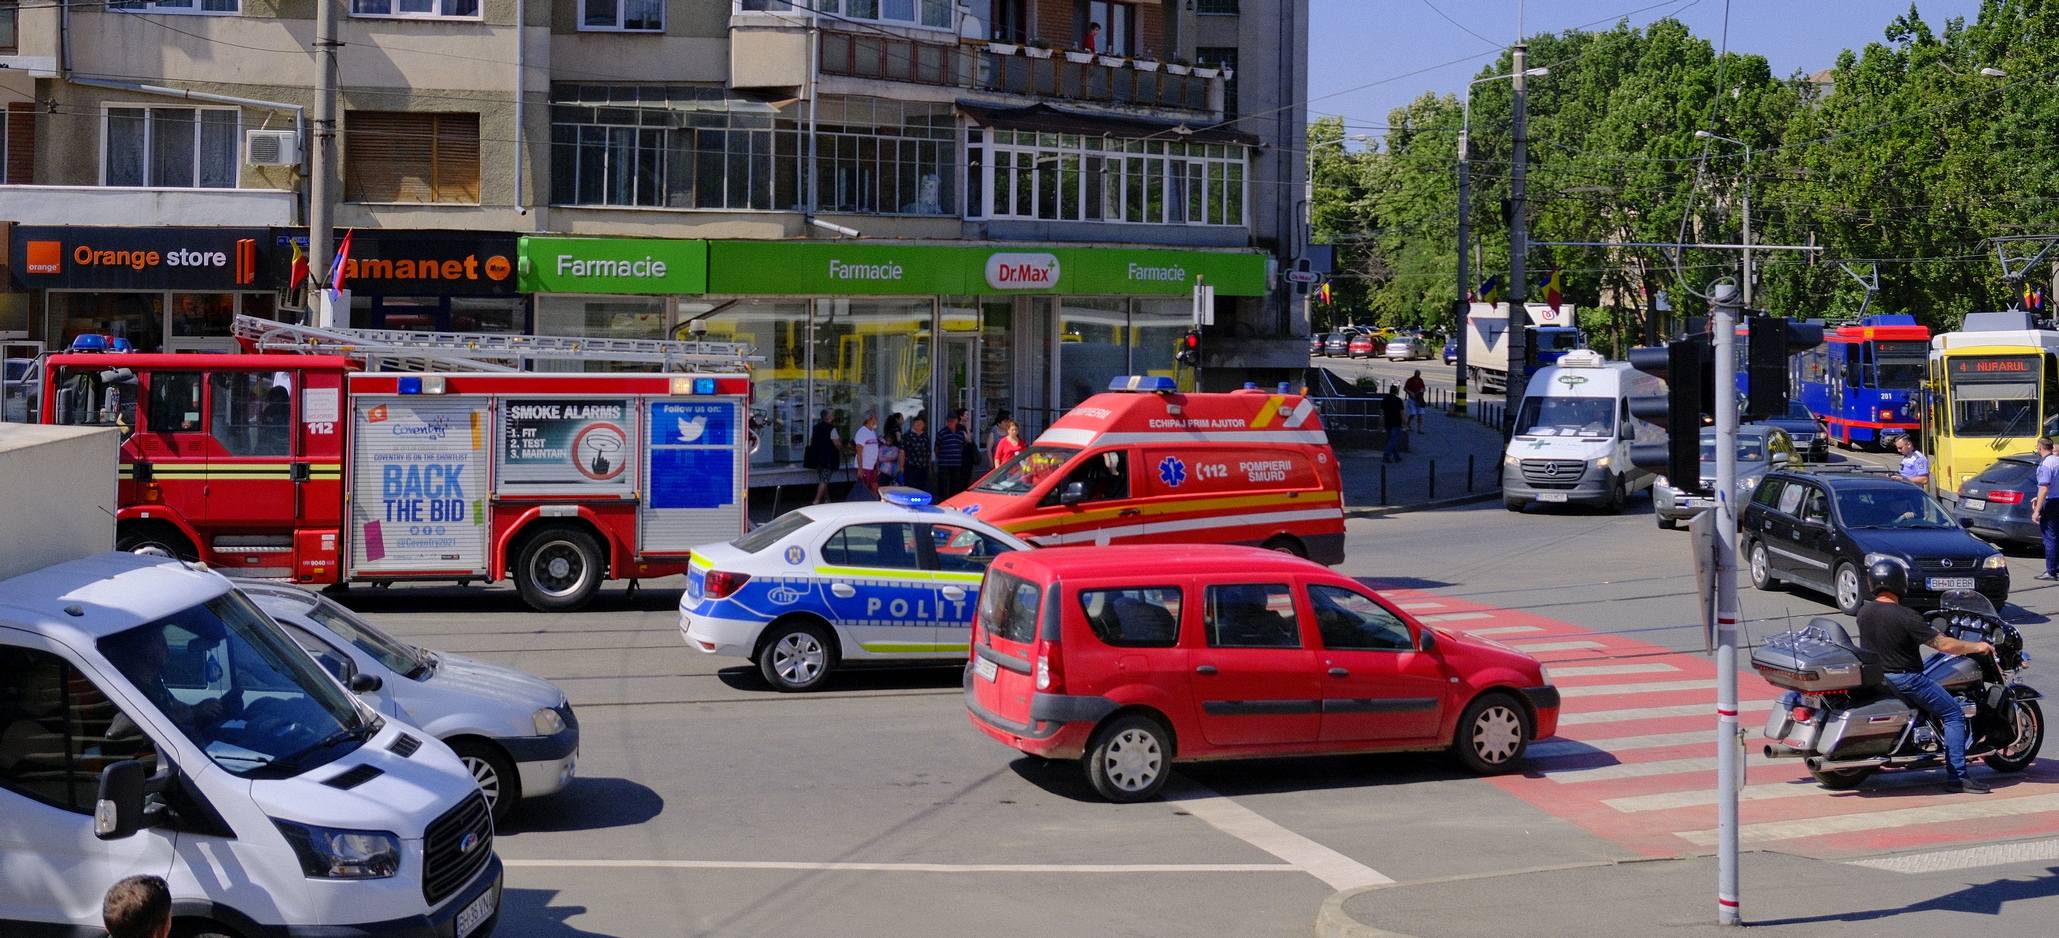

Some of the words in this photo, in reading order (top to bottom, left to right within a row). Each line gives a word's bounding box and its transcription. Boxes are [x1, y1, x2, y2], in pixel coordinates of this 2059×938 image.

[74, 246, 160, 270] Orange
[166, 248, 226, 267] store
[29, 264, 58, 272] orange
[345, 254, 479, 280] amanet
[558, 254, 667, 277] Farmacie
[829, 260, 902, 280] Farmacie
[1128, 262, 1185, 281] Farmacie
[998, 264, 1049, 282] Dr.Max
[1959, 362, 1967, 372] 4
[1977, 361, 2028, 372] NUFARUL
[511, 405, 561, 420] SMOKE
[563, 405, 621, 420] ALARMS
[663, 405, 693, 413] Follow
[308, 422, 333, 434] 112
[1149, 419, 1187, 428] ECHIPAJ
[1187, 419, 1210, 428] PRIM
[1211, 419, 1246, 428] AJUTOR
[392, 423, 446, 438] Coventry
[510, 428, 520, 438] 1.
[522, 428, 537, 438] FIT
[510, 439, 520, 448] 2.
[522, 439, 546, 448] TEST
[374, 453, 404, 461] COVENTRY
[406, 453, 412, 461] IS
[413, 453, 421, 461] ON
[424, 453, 434, 461] THE
[436, 453, 468, 461] SHORTLIST
[510, 449, 520, 459] 3.
[522, 449, 567, 459] MAINTAIN
[1203, 464, 1228, 477] 112
[1240, 460, 1292, 472] POMPIERII
[383, 464, 465, 498] BACK
[1248, 470, 1286, 482] SMURD
[383, 499, 423, 522] THE
[430, 499, 465, 522] BID
[1932, 579, 1944, 588] BH
[1947, 579, 1955, 588] 10
[1957, 579, 1974, 588] EBR
[867, 597, 967, 620] POLIT
